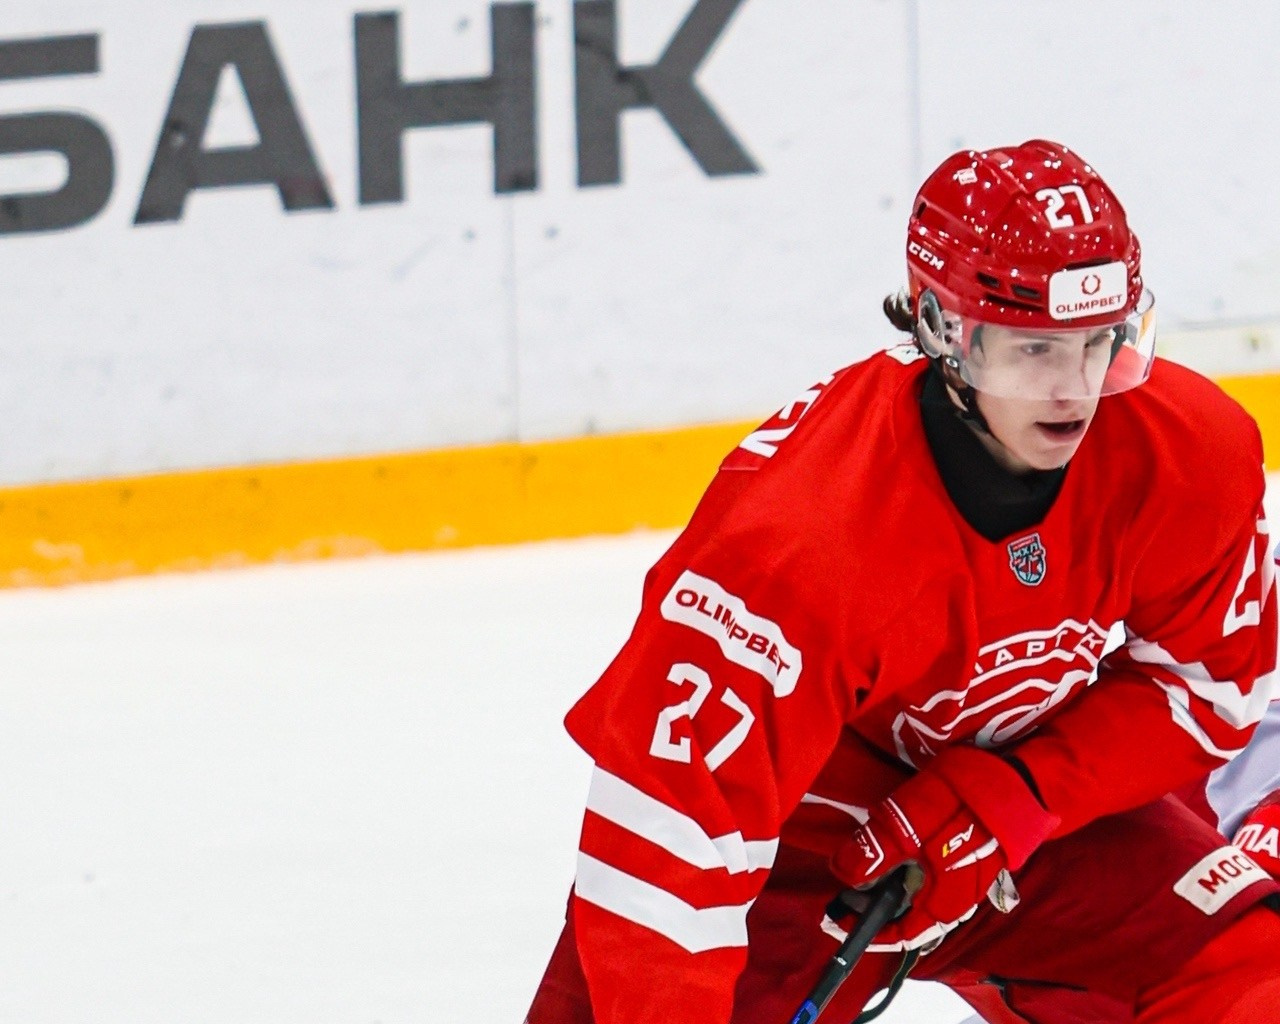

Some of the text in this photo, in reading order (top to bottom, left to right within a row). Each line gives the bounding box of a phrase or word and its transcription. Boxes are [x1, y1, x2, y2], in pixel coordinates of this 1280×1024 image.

[0, 0, 762, 235] БАНК
[1035, 185, 1094, 229] 27
[908, 240, 945, 271] CCM
[1055, 294, 1124, 314] OLIMPBET
[649, 662, 757, 774] 27
